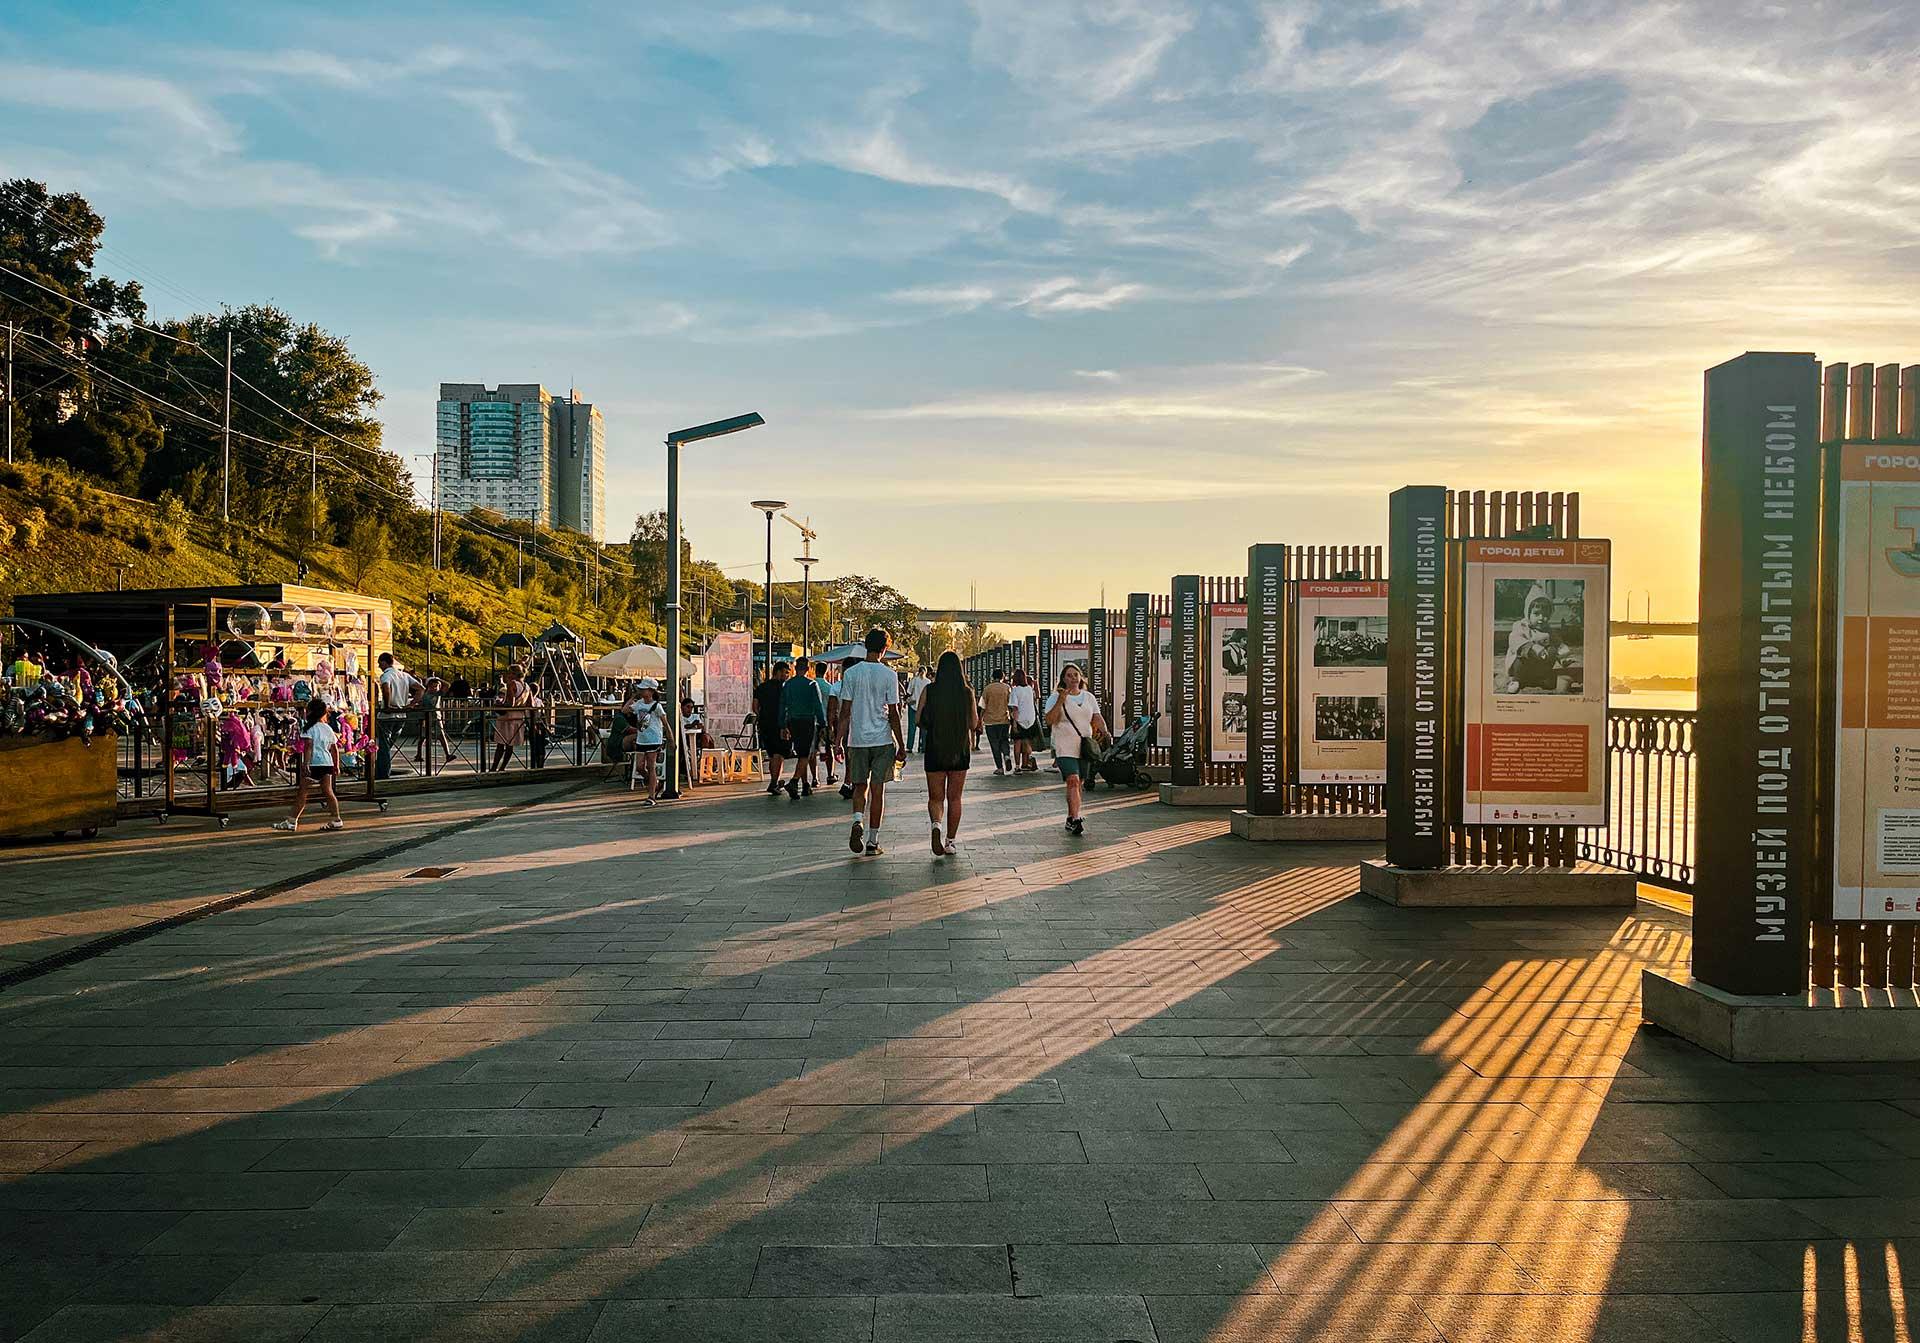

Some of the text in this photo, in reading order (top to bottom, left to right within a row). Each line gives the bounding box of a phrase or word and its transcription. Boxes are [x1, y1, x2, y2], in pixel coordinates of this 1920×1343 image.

[1480, 547, 1565, 557] ГОРОД ДЕТЕЙ
[1865, 455, 1920, 468] ГОРО
[1181, 592, 1196, 770] МУЗЕЙ ПОД ОТКРЫТЫМ НЕБОМ
[1260, 566, 1278, 793] МУЗЕЙ ПОД ОТКРЫТЫМ НЕБОМ
[1412, 516, 1436, 836] МУЗЕЙ ПОД ОТКРЫТЫМ НЕБОМ
[1751, 405, 1797, 941] МУЗЕЙ ПОД ОТКРЫТЫМ НЕБОМ
